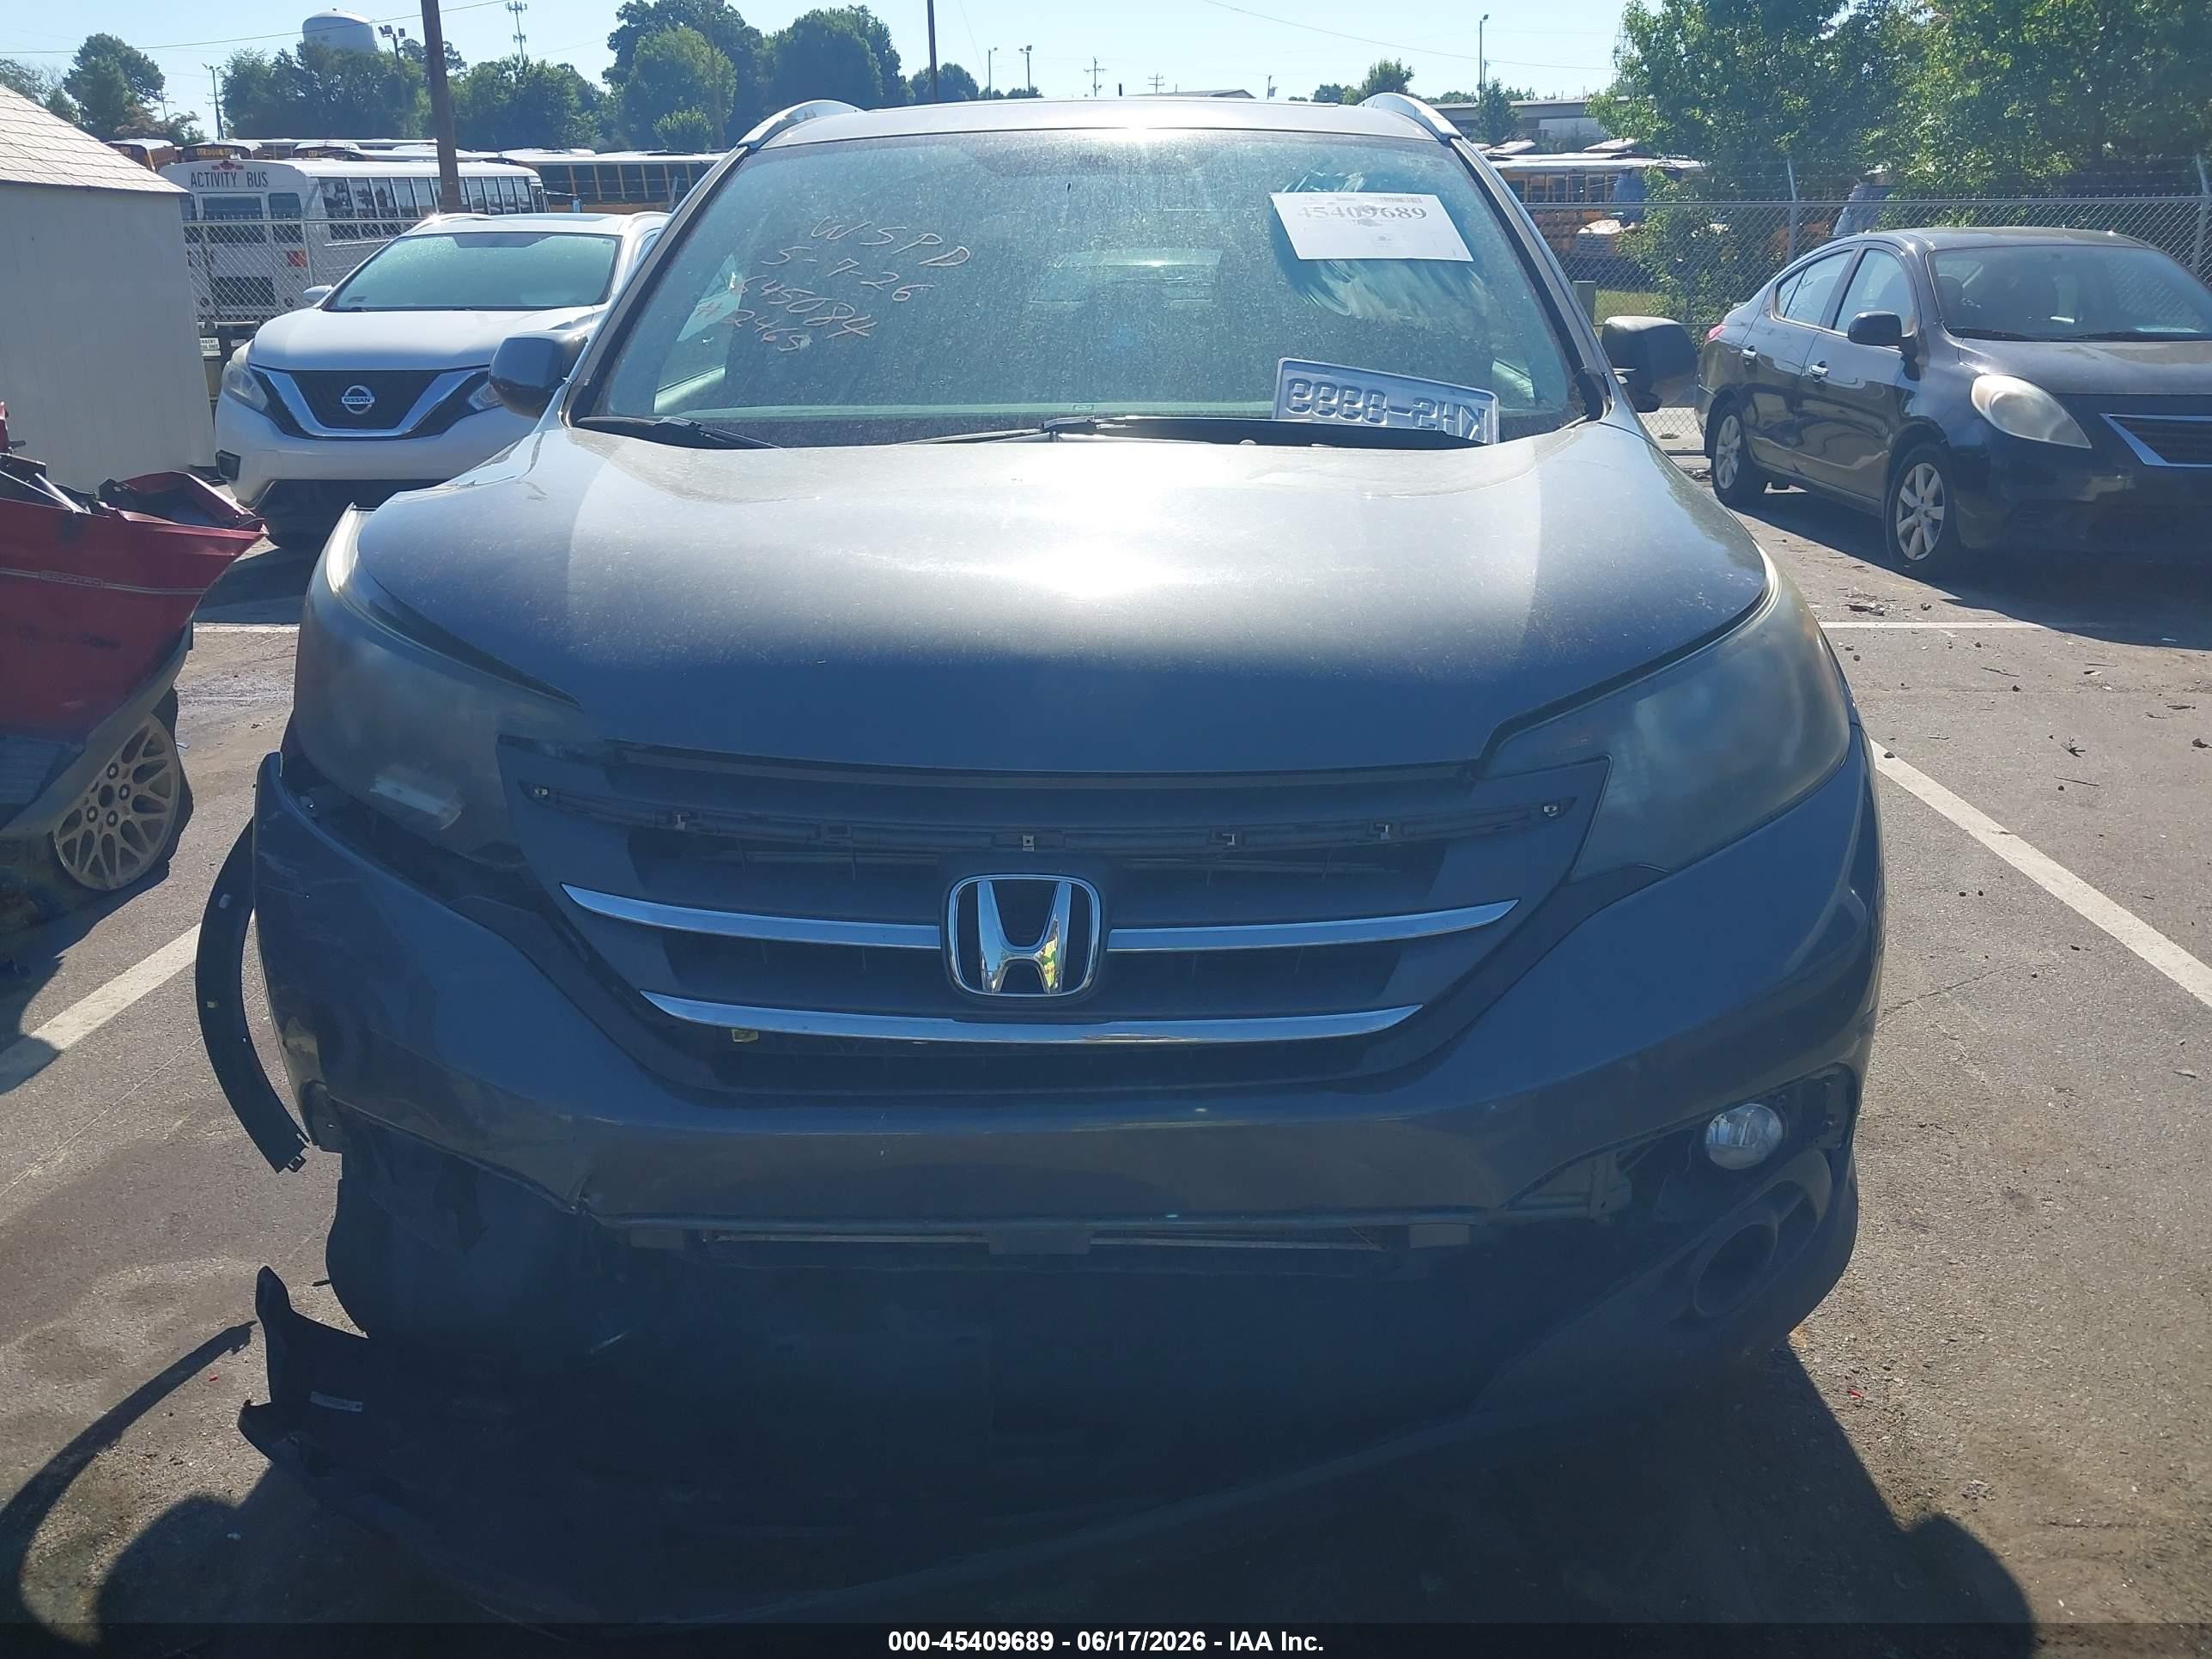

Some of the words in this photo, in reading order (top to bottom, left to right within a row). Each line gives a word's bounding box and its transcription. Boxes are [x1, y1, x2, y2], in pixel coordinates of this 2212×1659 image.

[191, 172, 237, 188] ACTIVITY
[246, 172, 268, 187] BUS
[1297, 205, 1427, 220] 45409689
